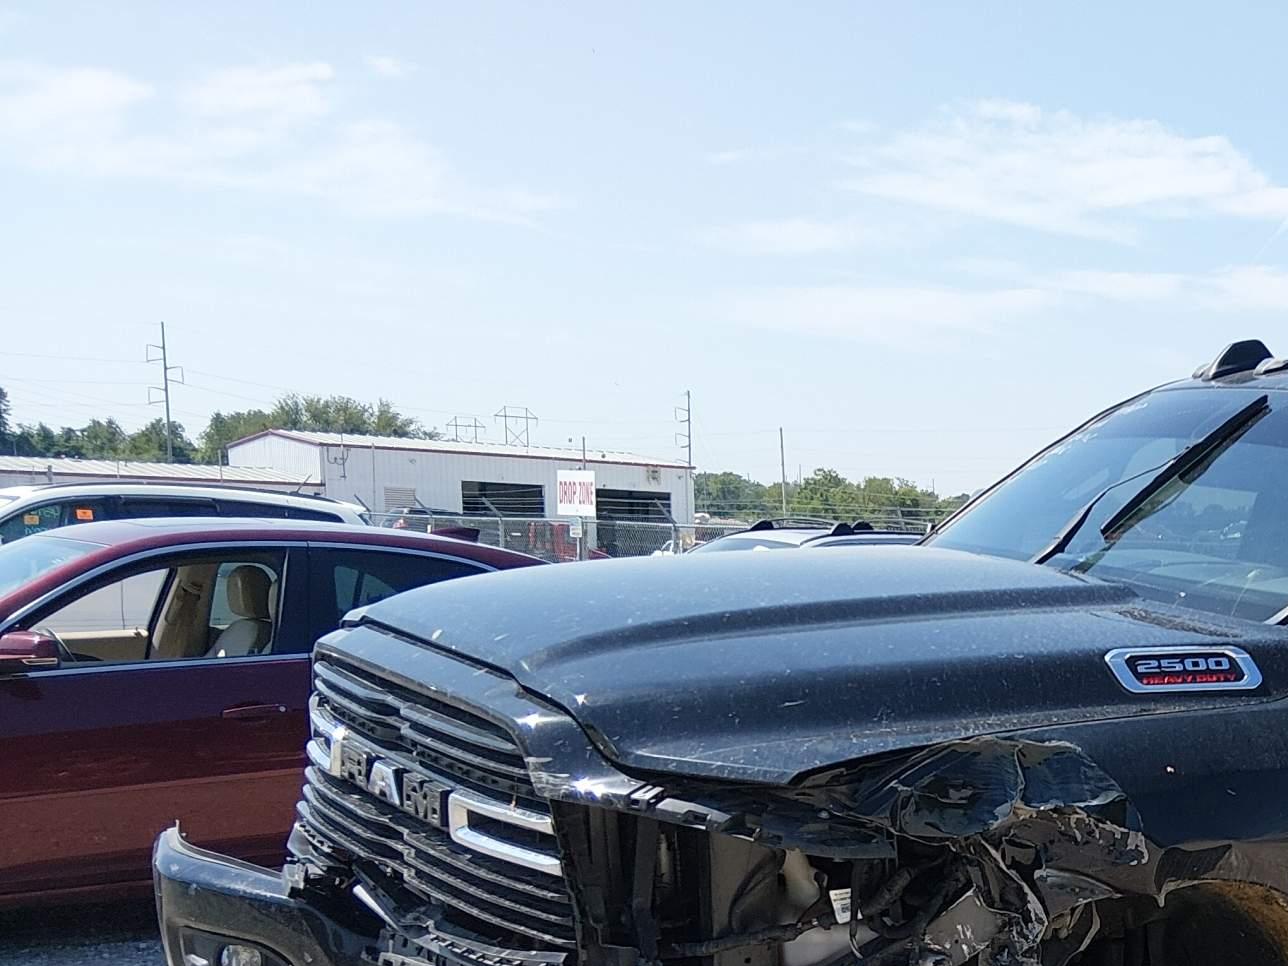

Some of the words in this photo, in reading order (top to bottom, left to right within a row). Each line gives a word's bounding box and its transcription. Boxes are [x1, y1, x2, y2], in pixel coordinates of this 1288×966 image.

[559, 480, 577, 504] DROP
[578, 481, 594, 505] ZONE
[1135, 657, 1231, 673] 2500
[1141, 675, 1193, 686] HEAVY
[1196, 673, 1237, 684] DUTY
